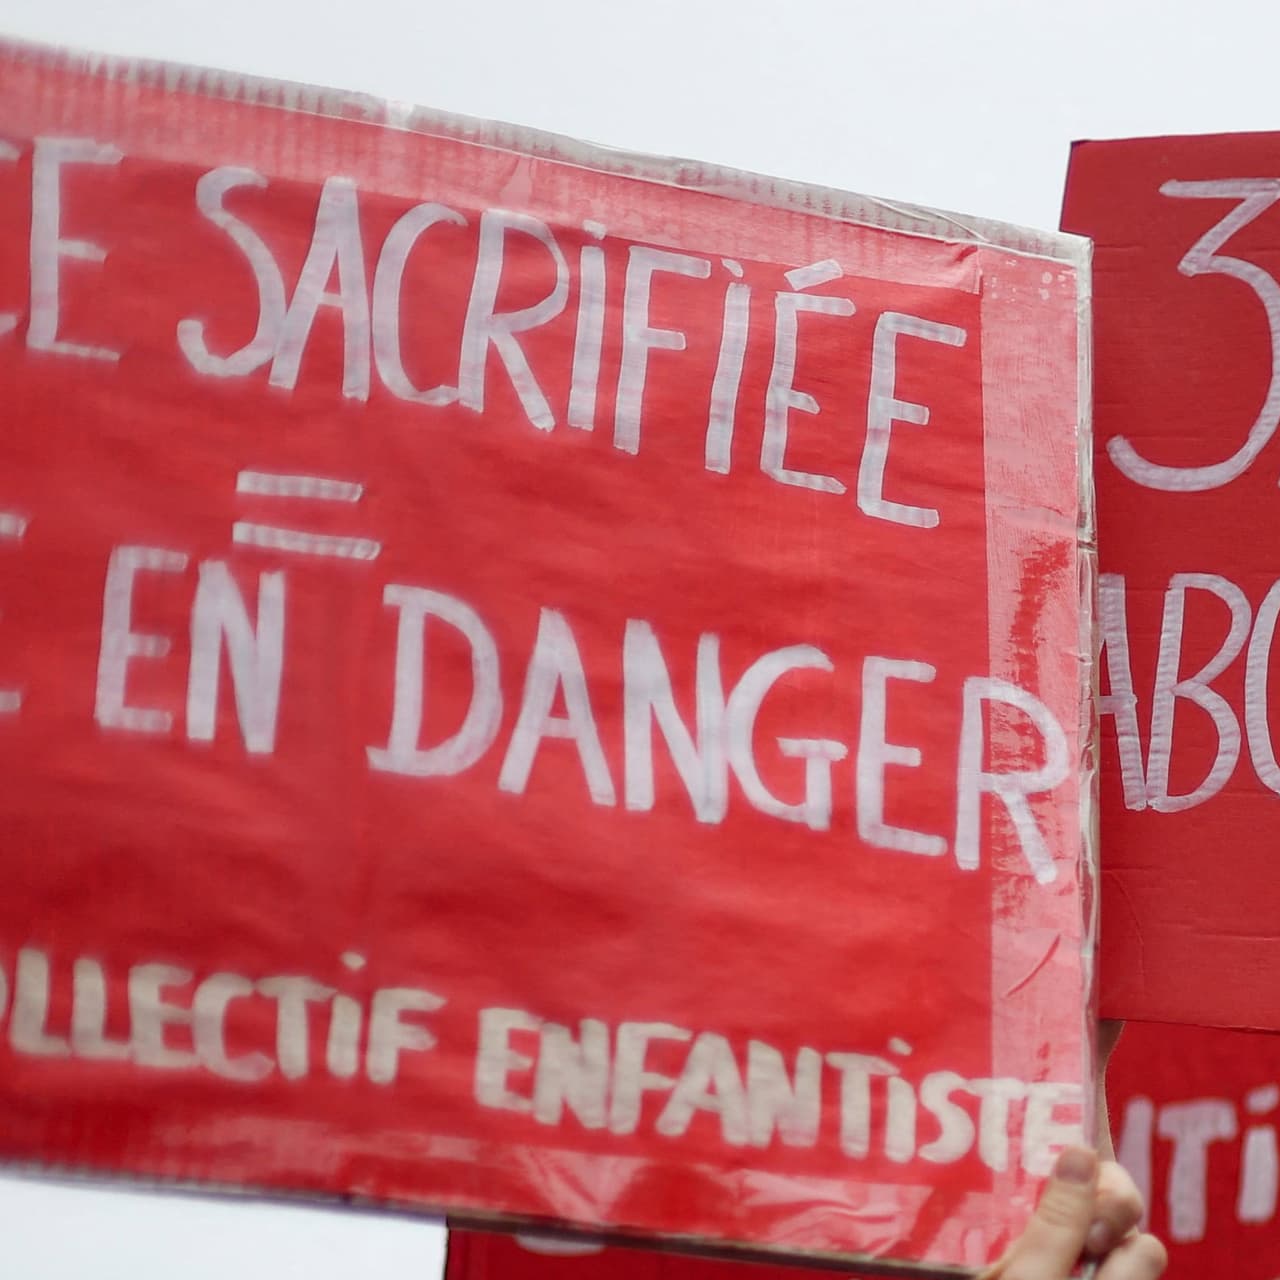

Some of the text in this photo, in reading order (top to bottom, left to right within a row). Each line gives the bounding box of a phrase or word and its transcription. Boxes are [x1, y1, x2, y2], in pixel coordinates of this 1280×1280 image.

[0, 137, 123, 361] E
[94, 545, 286, 753] EN
[366, 584, 1073, 885] DANGER
[0, 948, 447, 1085] LLECTiF
